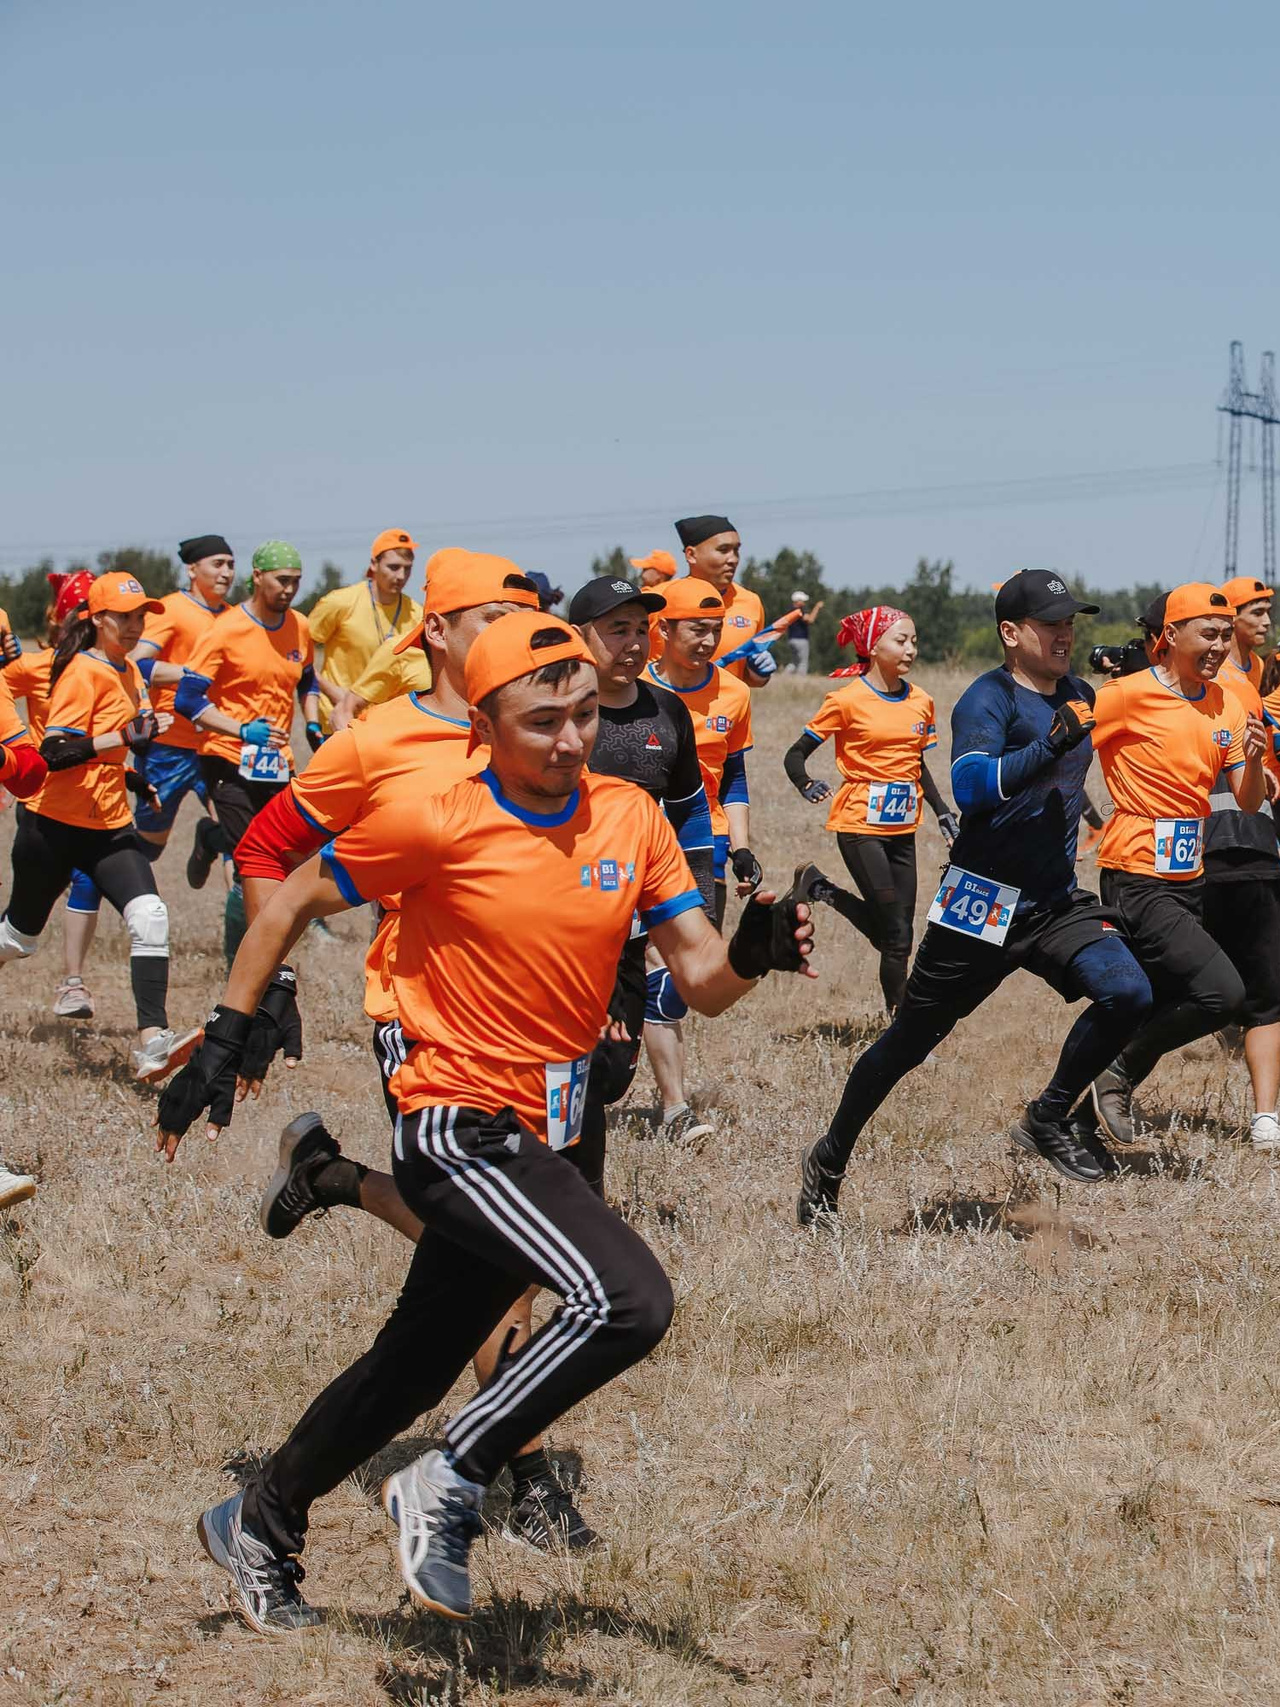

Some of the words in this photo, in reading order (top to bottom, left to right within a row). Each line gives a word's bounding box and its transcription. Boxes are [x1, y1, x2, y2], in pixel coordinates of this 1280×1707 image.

[255, 755, 280, 774] 44
[884, 797, 908, 817] 44
[1175, 838, 1196, 862] 62
[602, 864, 615, 874] BI
[964, 880, 978, 892] BI
[950, 894, 988, 926] 49
